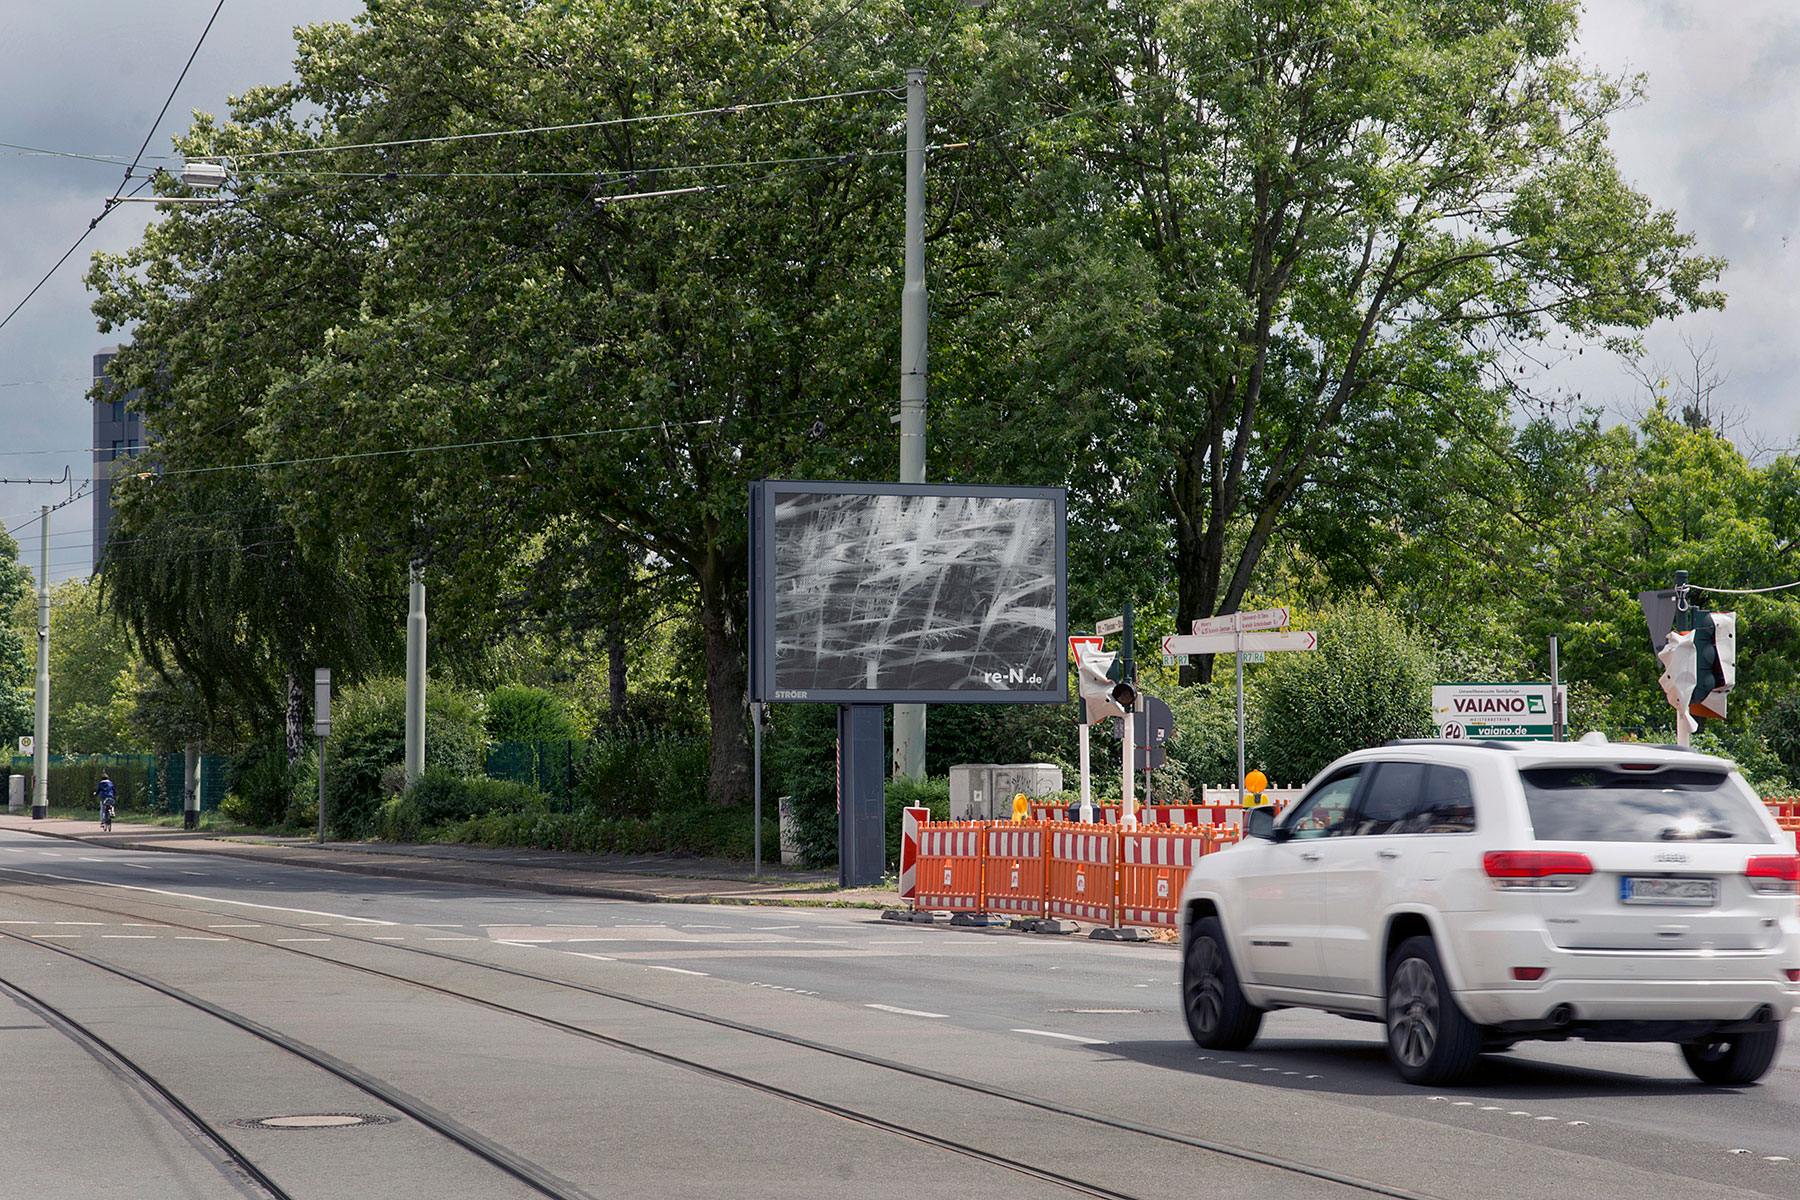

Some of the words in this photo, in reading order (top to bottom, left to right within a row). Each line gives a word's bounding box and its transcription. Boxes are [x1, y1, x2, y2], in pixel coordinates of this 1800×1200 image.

[1163, 656, 1174, 665] R1
[1178, 655, 1188, 664] R7
[1243, 653, 1252, 662] R7
[1254, 653, 1264, 661] R6
[775, 690, 808, 699] STRÖER
[1453, 697, 1525, 713] VAIANO
[1478, 725, 1527, 735] vaiano.de
